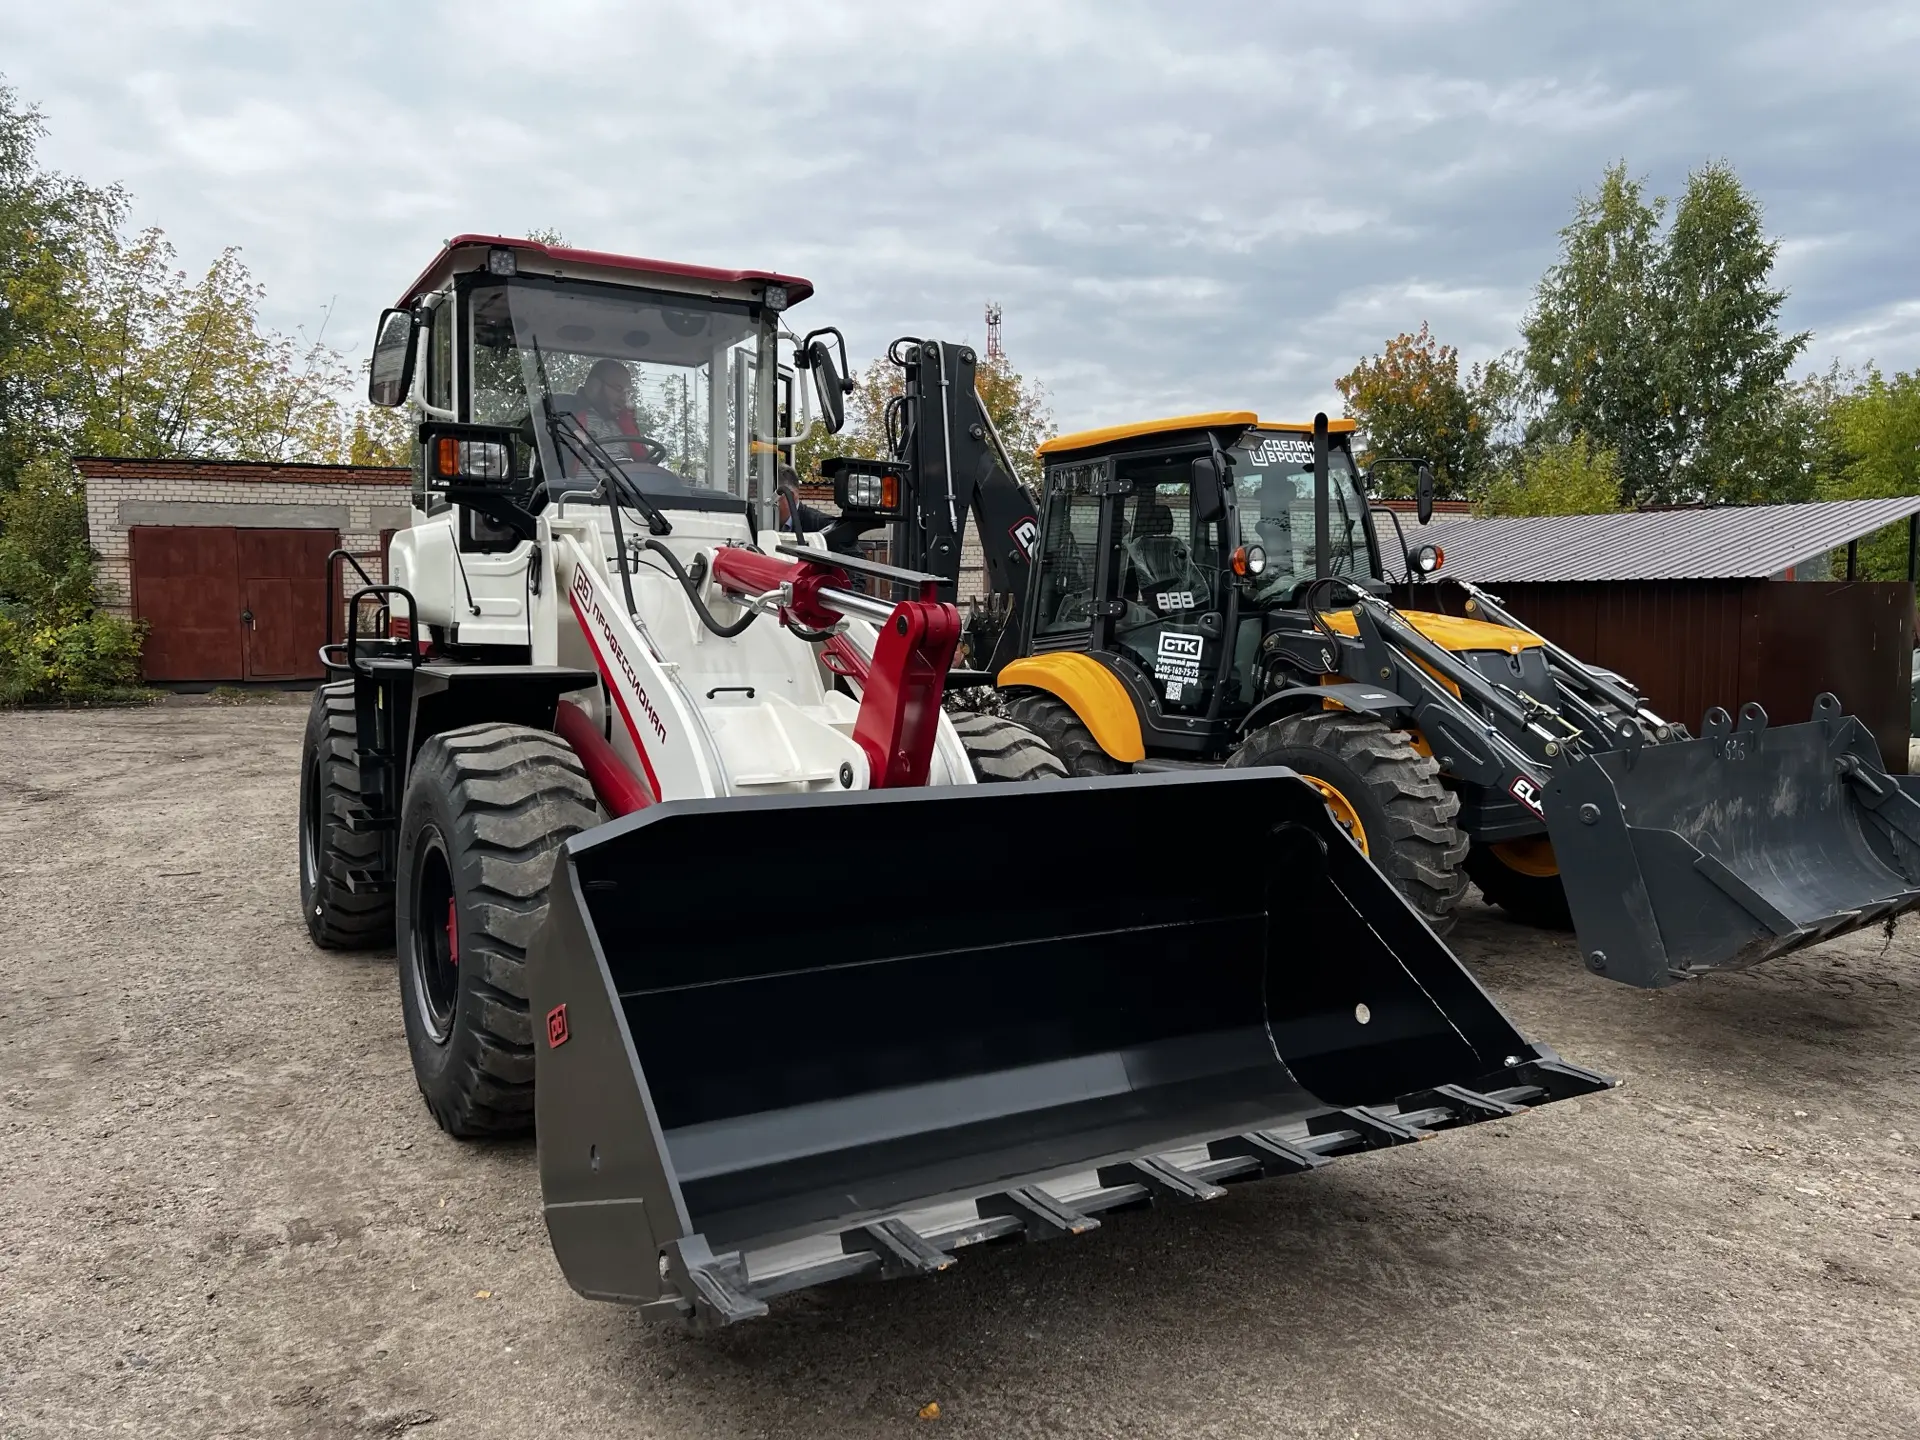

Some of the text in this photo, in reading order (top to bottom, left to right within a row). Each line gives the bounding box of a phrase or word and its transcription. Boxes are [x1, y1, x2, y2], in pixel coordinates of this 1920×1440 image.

[1263, 440, 1315, 452] СДЕЛАН
[1156, 591, 1195, 609] 888
[1164, 639, 1197, 653] СТК
[592, 602, 668, 745] ПРОФЕССИОНАЛ
